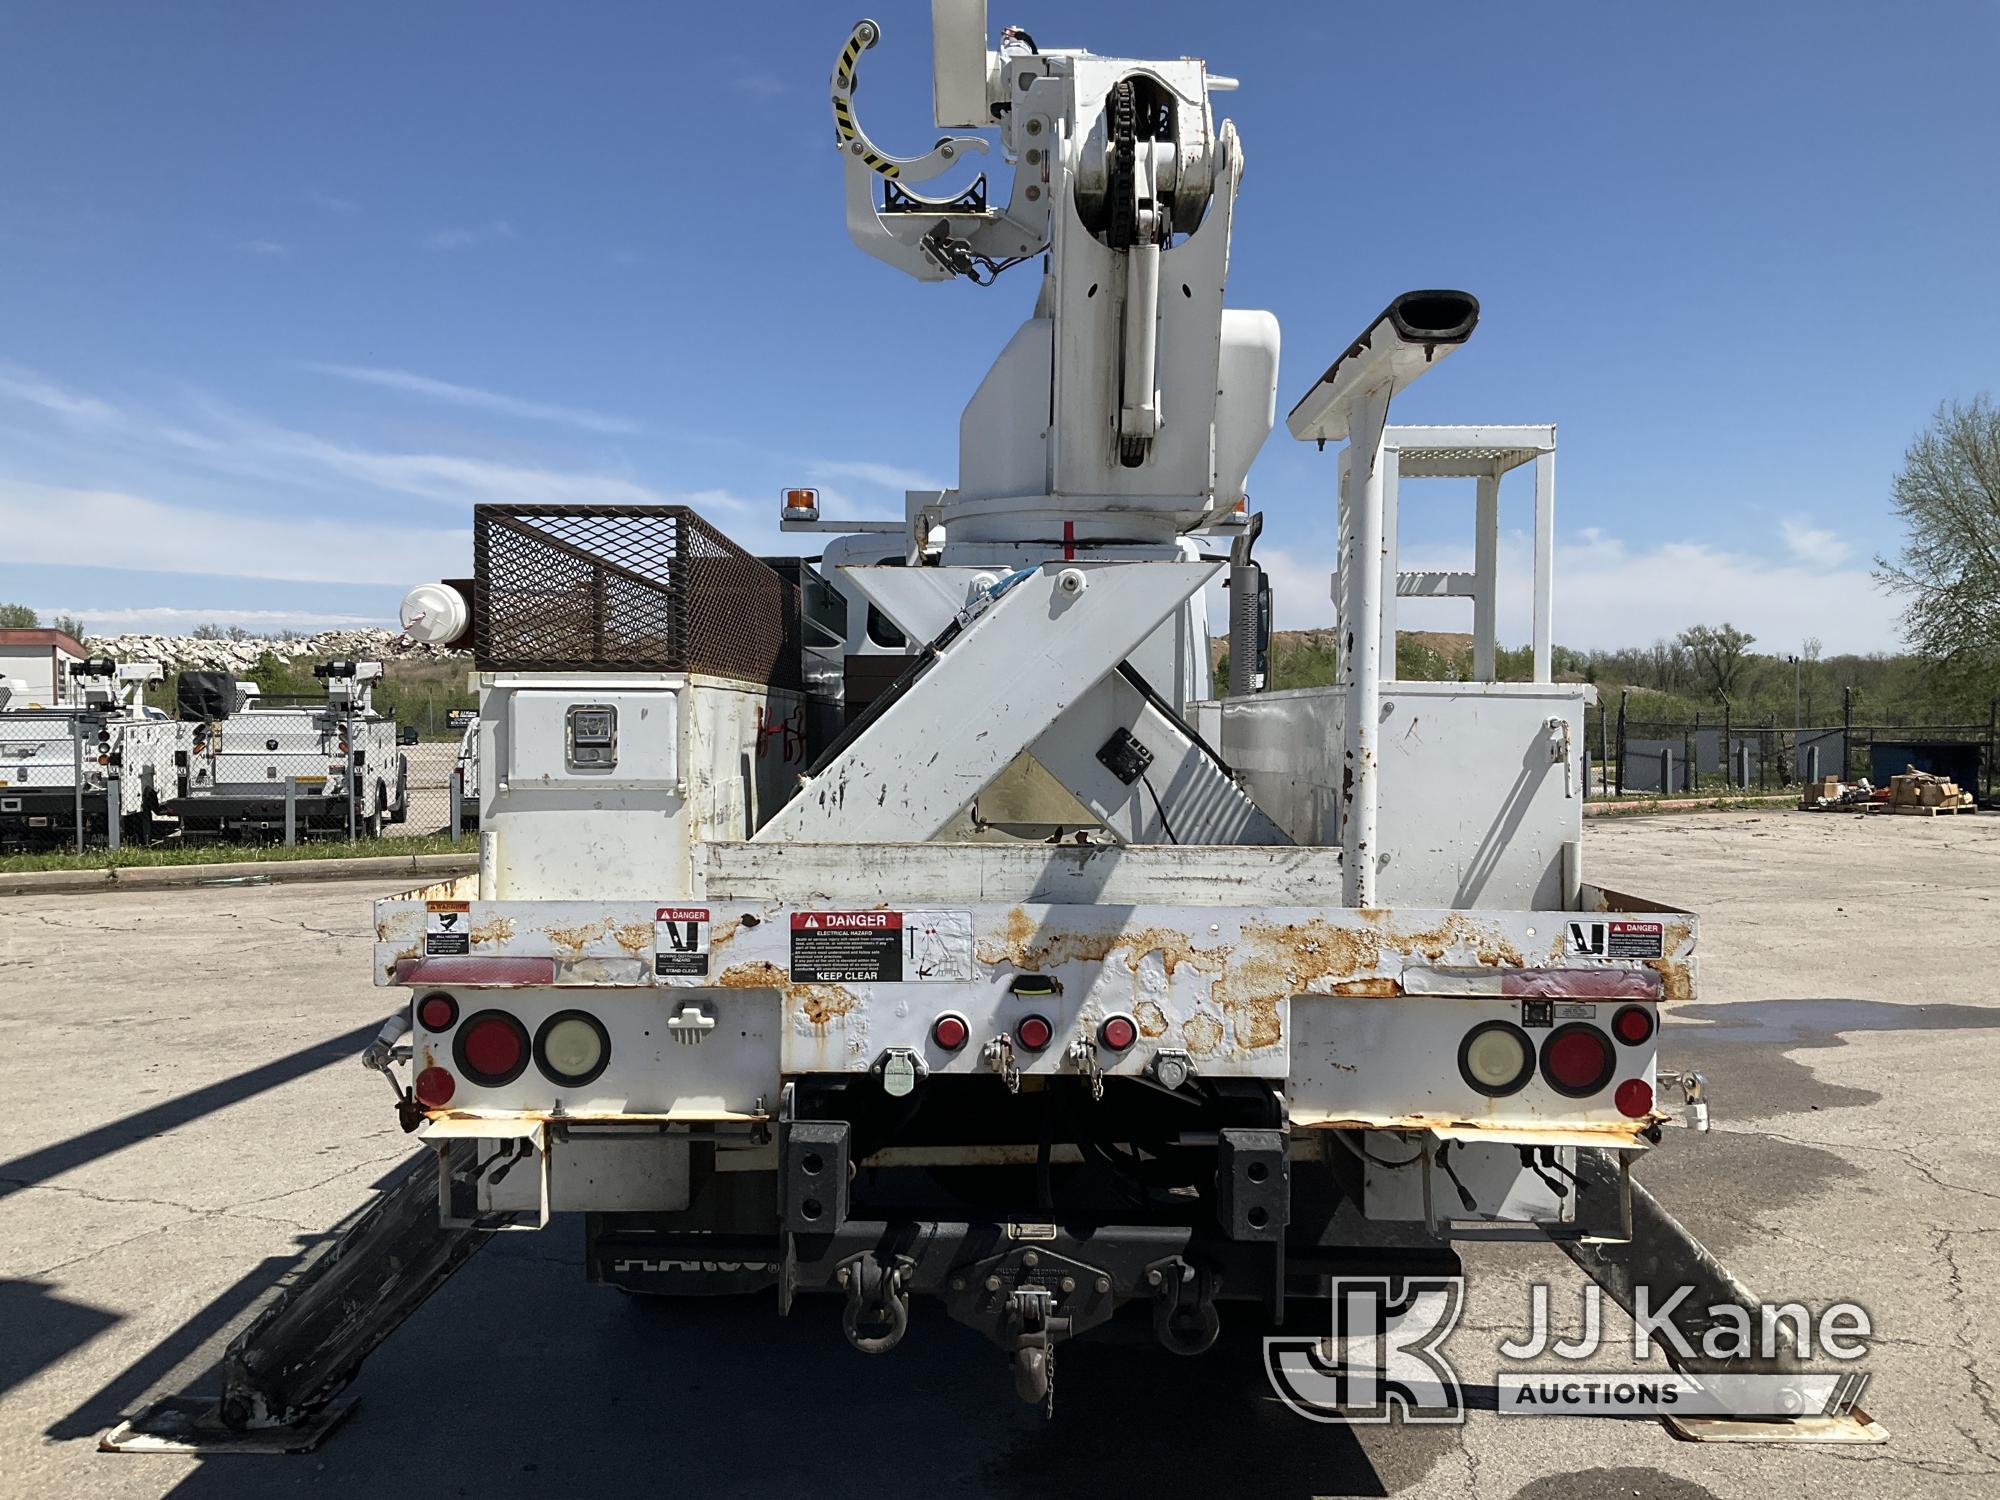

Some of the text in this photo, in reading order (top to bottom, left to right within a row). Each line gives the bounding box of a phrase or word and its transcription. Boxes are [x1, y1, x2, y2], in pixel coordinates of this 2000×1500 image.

[672, 911, 705, 919] DANGER
[826, 915, 886, 926] DANGER
[1626, 924, 1658, 932] DANGER
[816, 972, 878, 980] KEEP CLEAR
